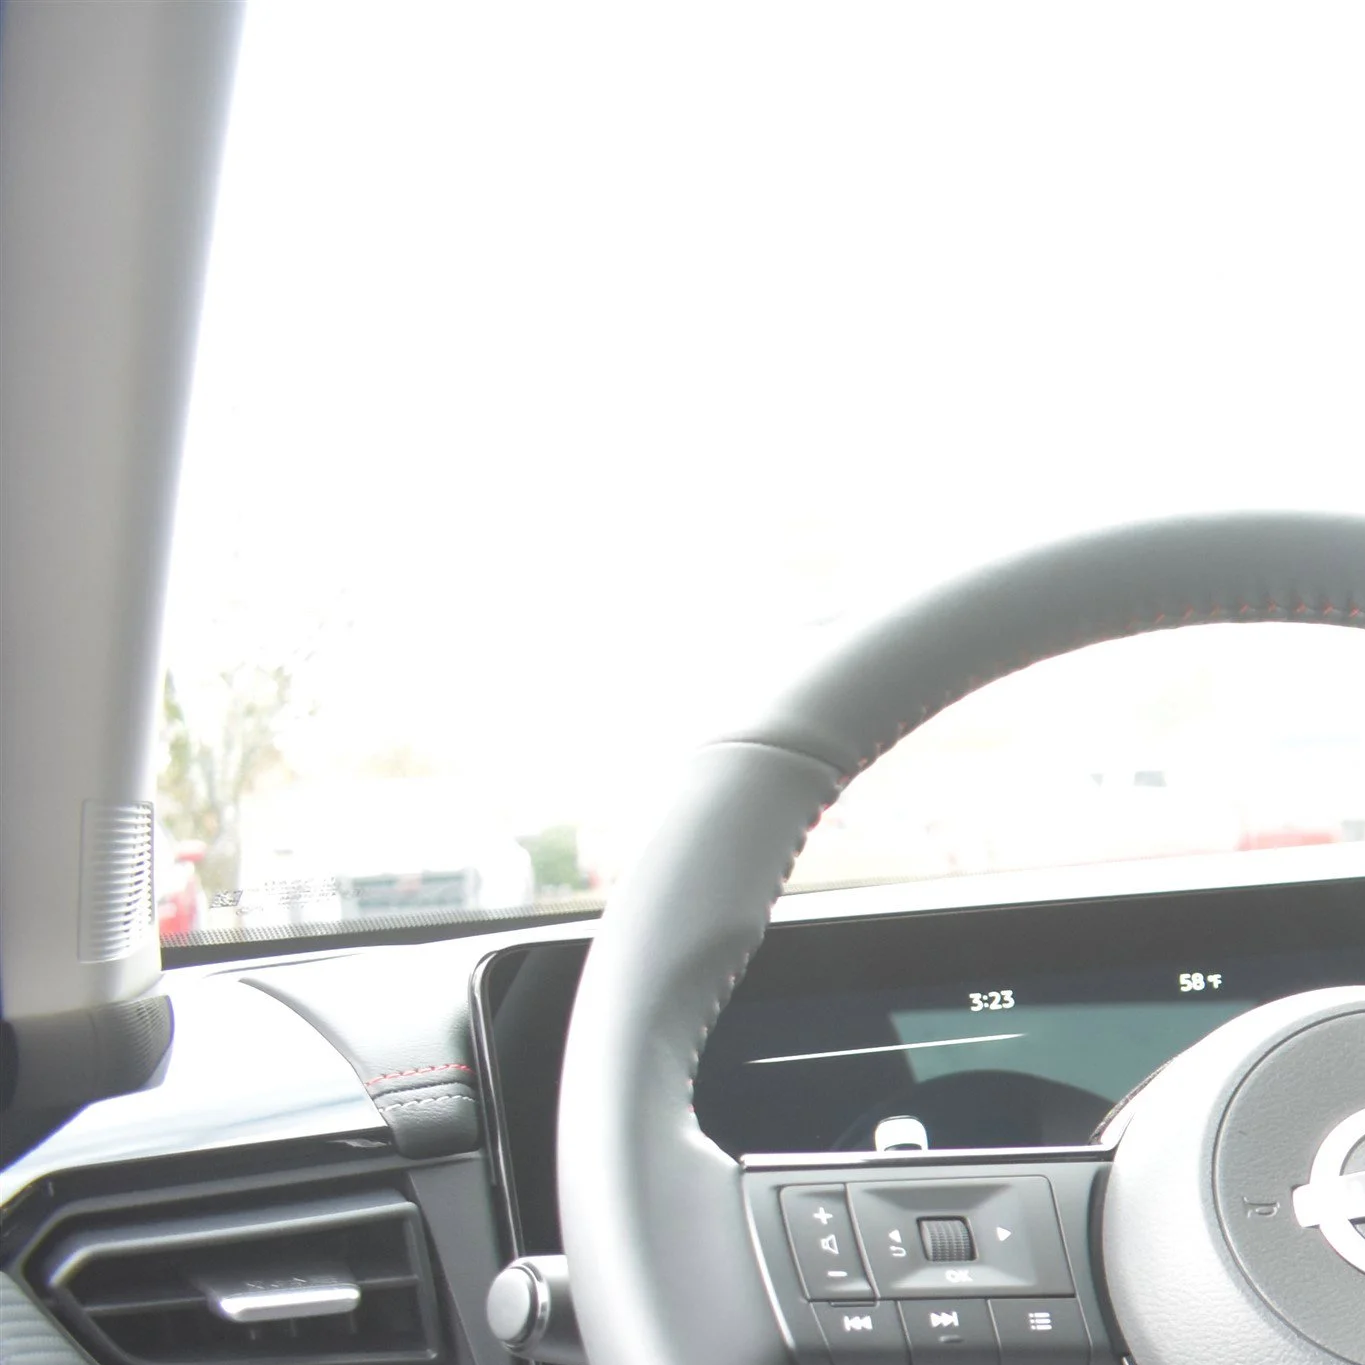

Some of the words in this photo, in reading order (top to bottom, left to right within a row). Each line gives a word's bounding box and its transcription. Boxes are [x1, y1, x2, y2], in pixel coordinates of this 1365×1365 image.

[1179, 972, 1205, 992] 58
[969, 990, 1015, 1012] 3:23
[946, 1269, 973, 1283] OK
